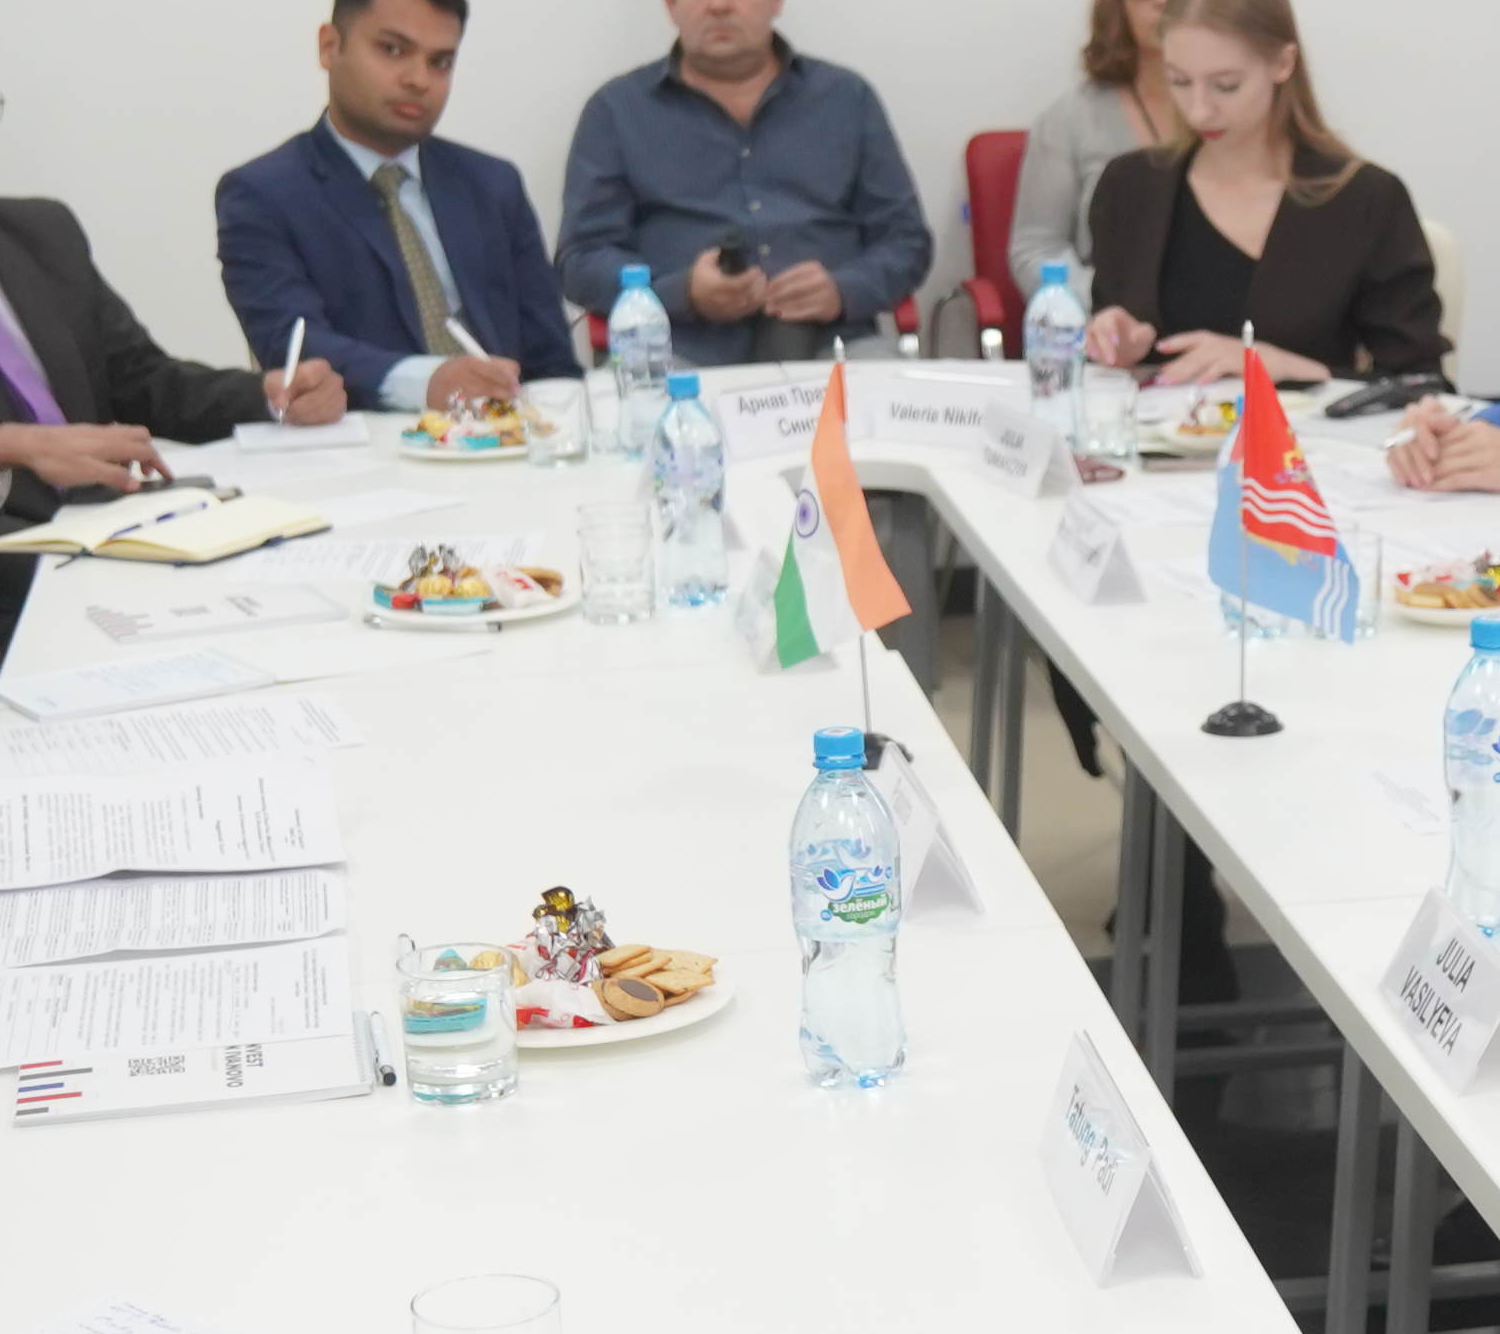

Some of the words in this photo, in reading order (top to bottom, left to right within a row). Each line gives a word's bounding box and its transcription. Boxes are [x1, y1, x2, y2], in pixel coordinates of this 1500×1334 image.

[739, 393, 790, 417] Арнав
[791, 385, 827, 408] Пра
[943, 406, 984, 428] Nikif
[779, 417, 819, 438] Синг
[1436, 937, 1476, 993] JULIA
[1400, 964, 1462, 1056] VASILYEVA
